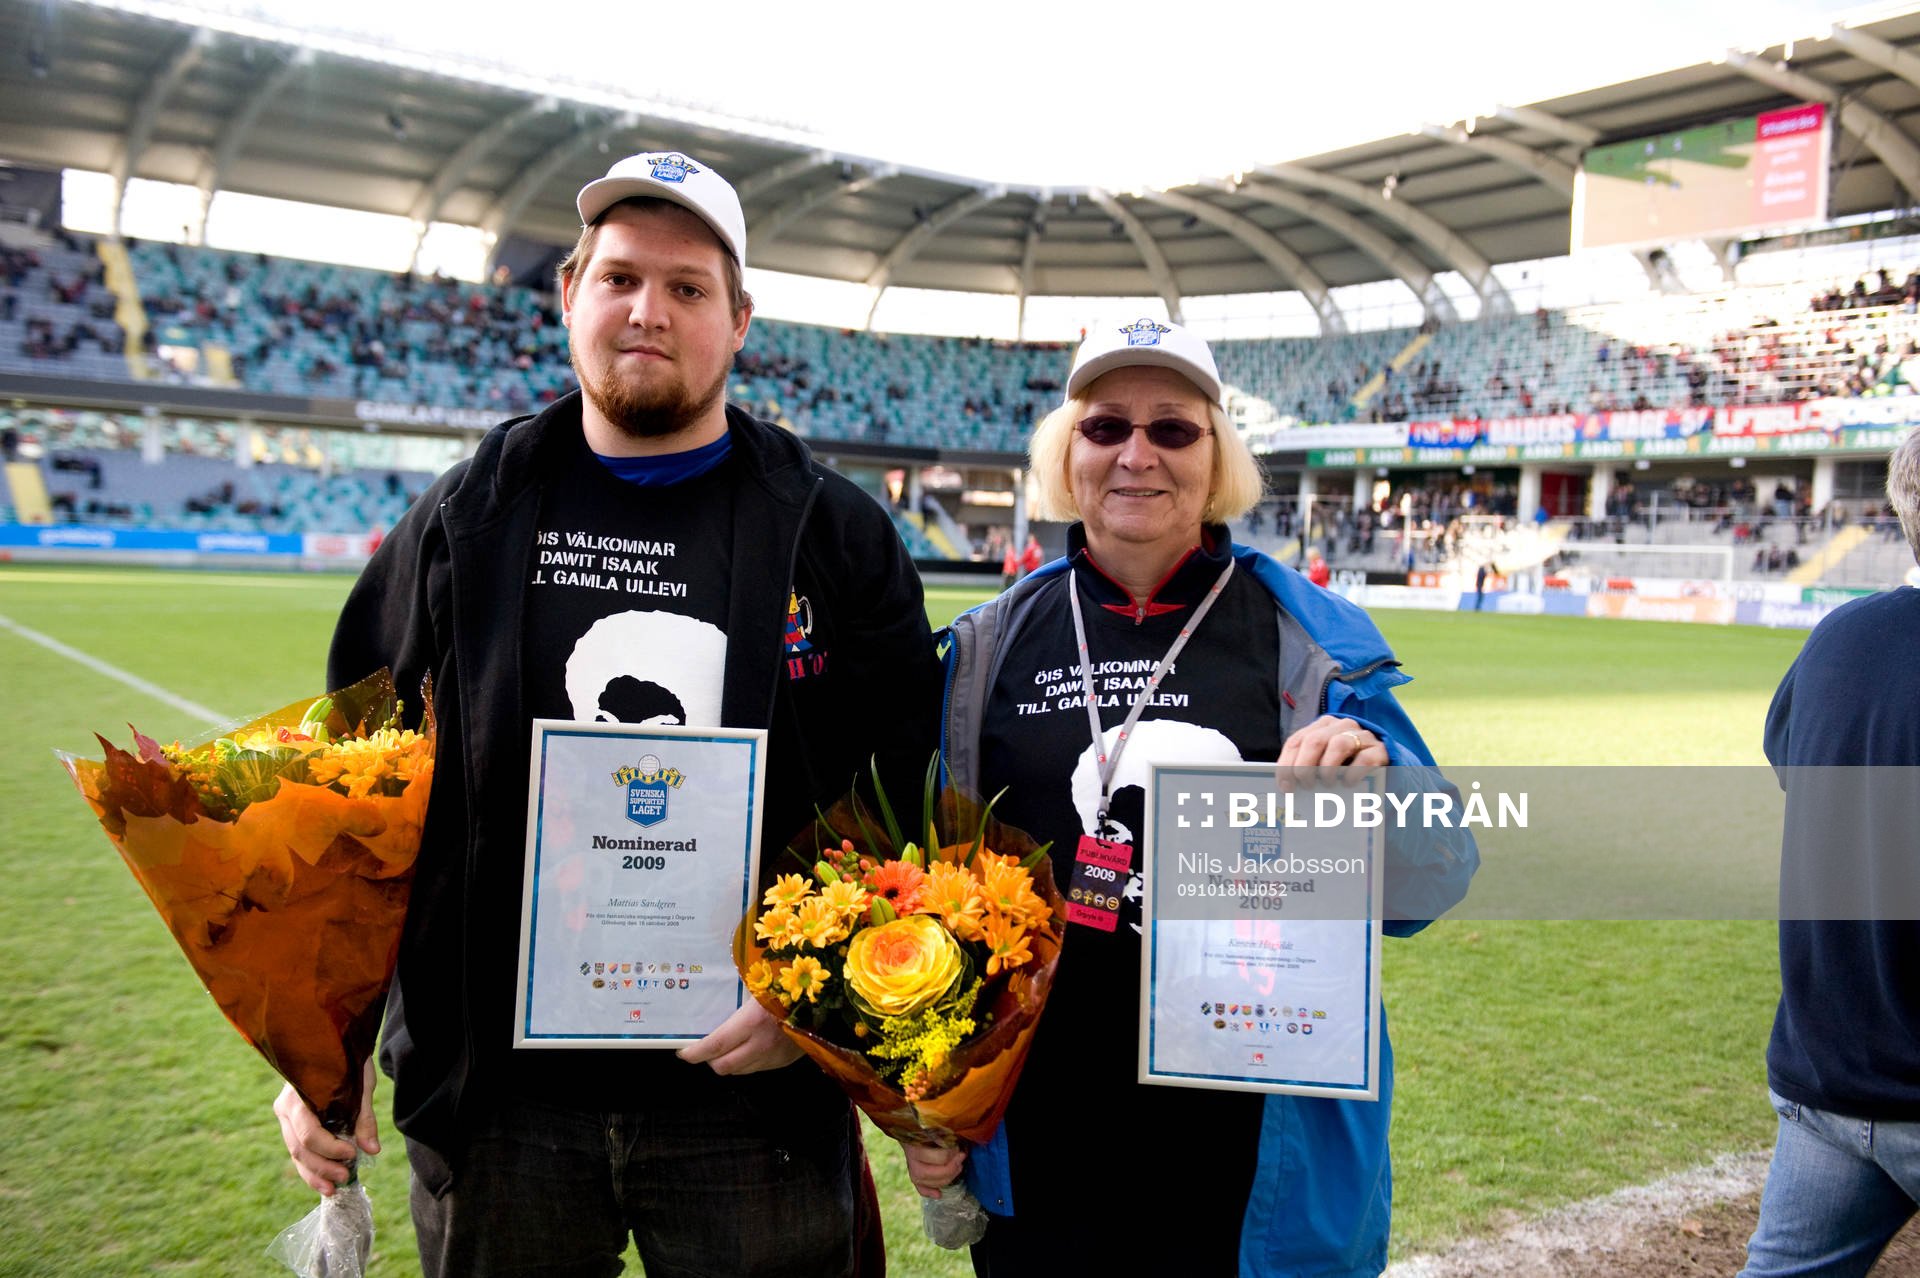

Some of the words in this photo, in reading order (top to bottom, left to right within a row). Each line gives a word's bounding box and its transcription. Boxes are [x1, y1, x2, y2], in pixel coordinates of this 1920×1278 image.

[565, 531, 676, 557] VÄLKOMNAR
[540, 551, 596, 568] DAWIT
[602, 556, 659, 575] ISAAK
[553, 570, 619, 591] GAMLA
[625, 578, 687, 597] ULLEVI
[1035, 668, 1063, 685] ÖIS
[1017, 702, 1051, 715] TILL
[1127, 694, 1189, 707] ULEVI
[629, 797, 665, 806] SUPPORTER
[630, 788, 665, 798] SVENSKA
[632, 805, 662, 816] LAGET
[592, 835, 697, 852] Nominerad
[622, 856, 665, 870] 2009
[1084, 864, 1117, 883] 2009
[1208, 874, 1315, 893] Nominerad
[1240, 895, 1283, 911] 2009
